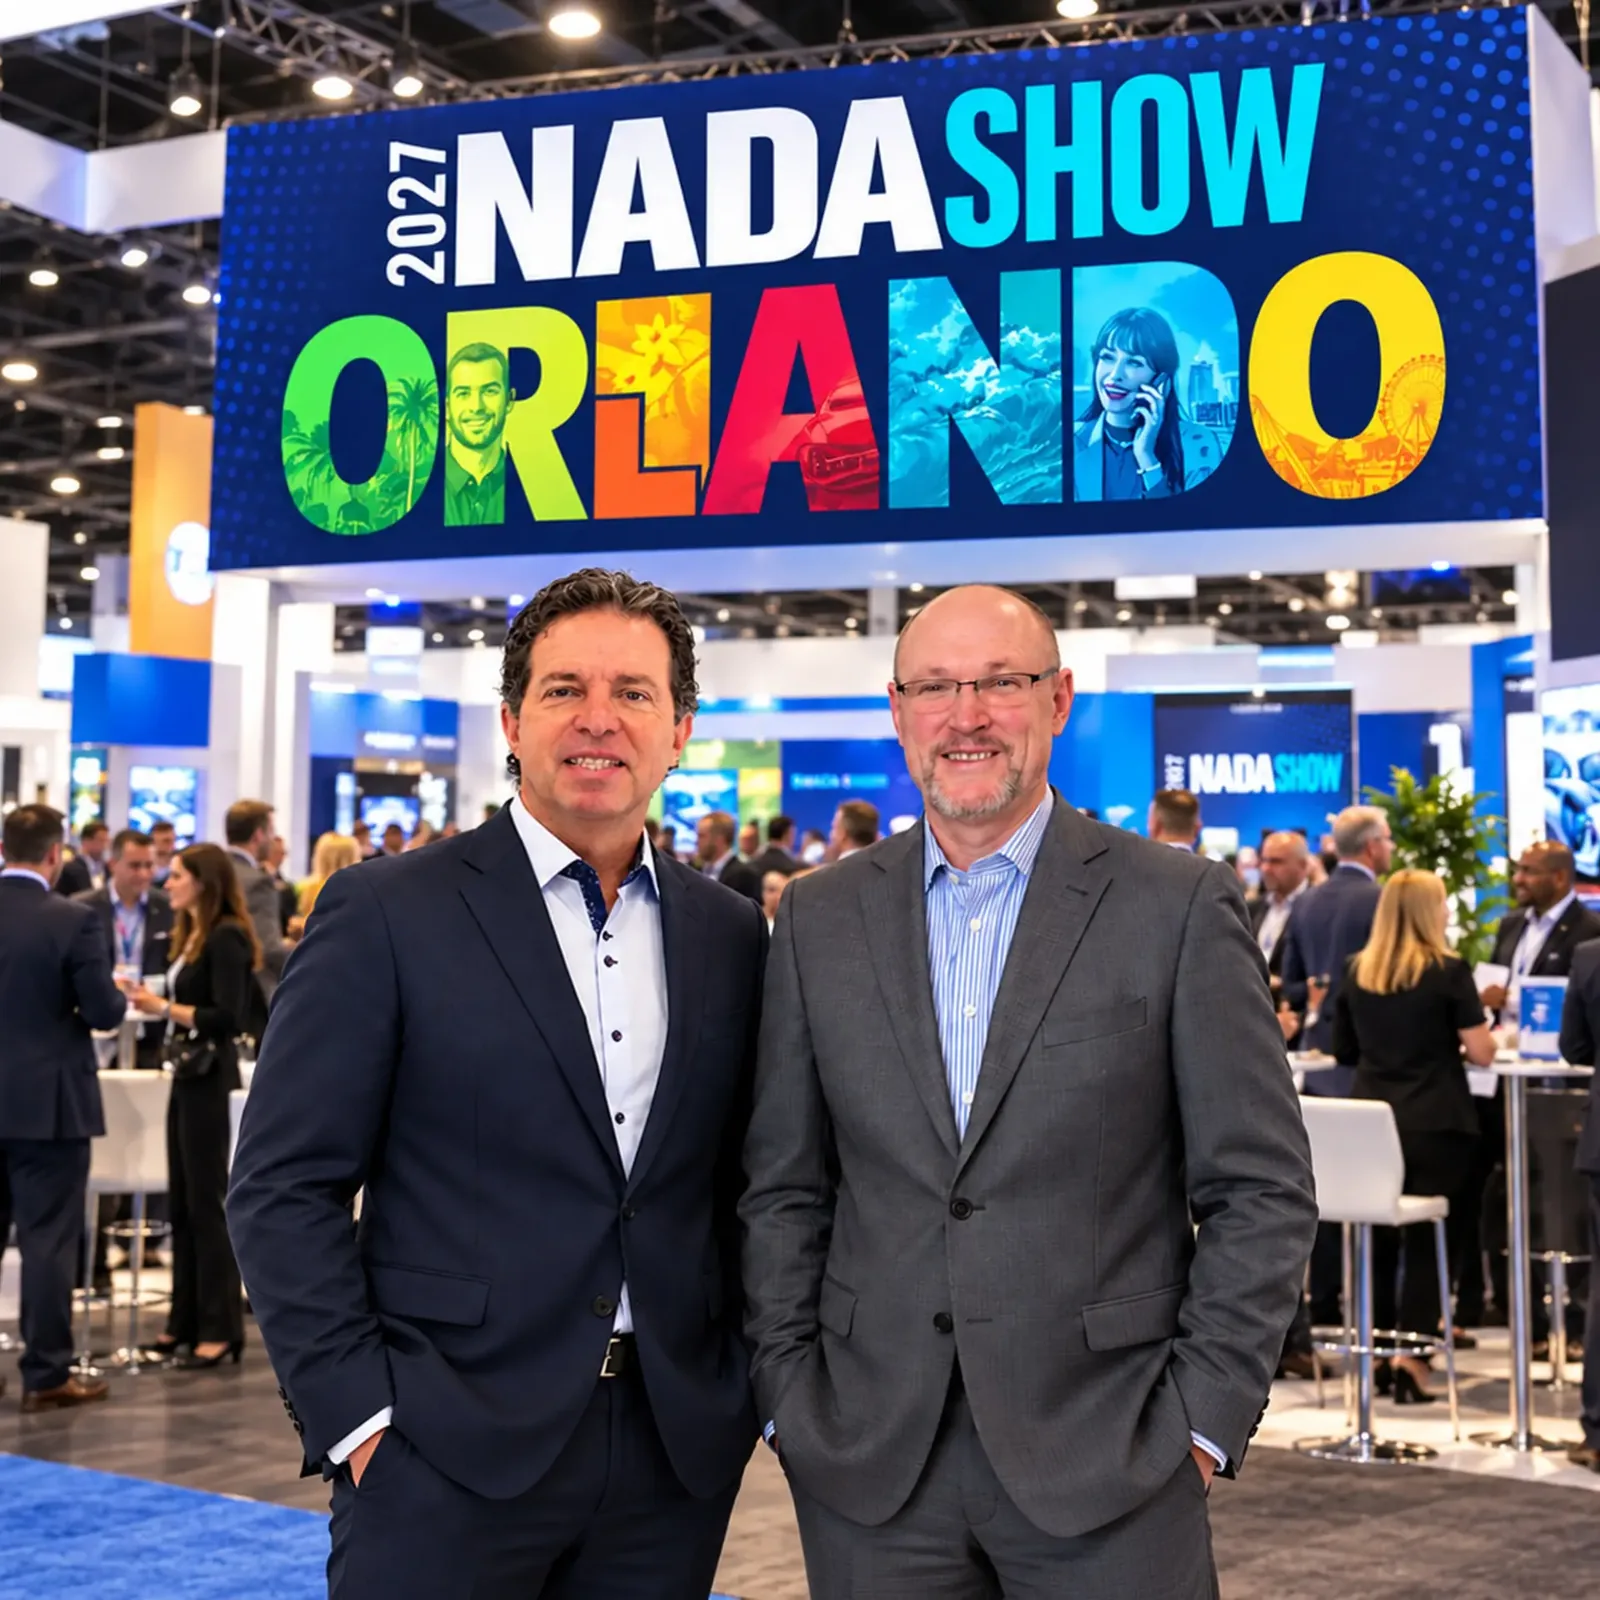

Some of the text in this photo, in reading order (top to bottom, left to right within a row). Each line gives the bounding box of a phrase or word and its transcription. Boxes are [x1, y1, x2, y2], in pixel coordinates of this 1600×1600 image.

[386, 63, 1326, 287] 2027 NADA SHOW
[281, 251, 1447, 536] ORLANDO
[1189, 753, 1276, 794] NADA
[1275, 752, 1343, 793] SHOW
